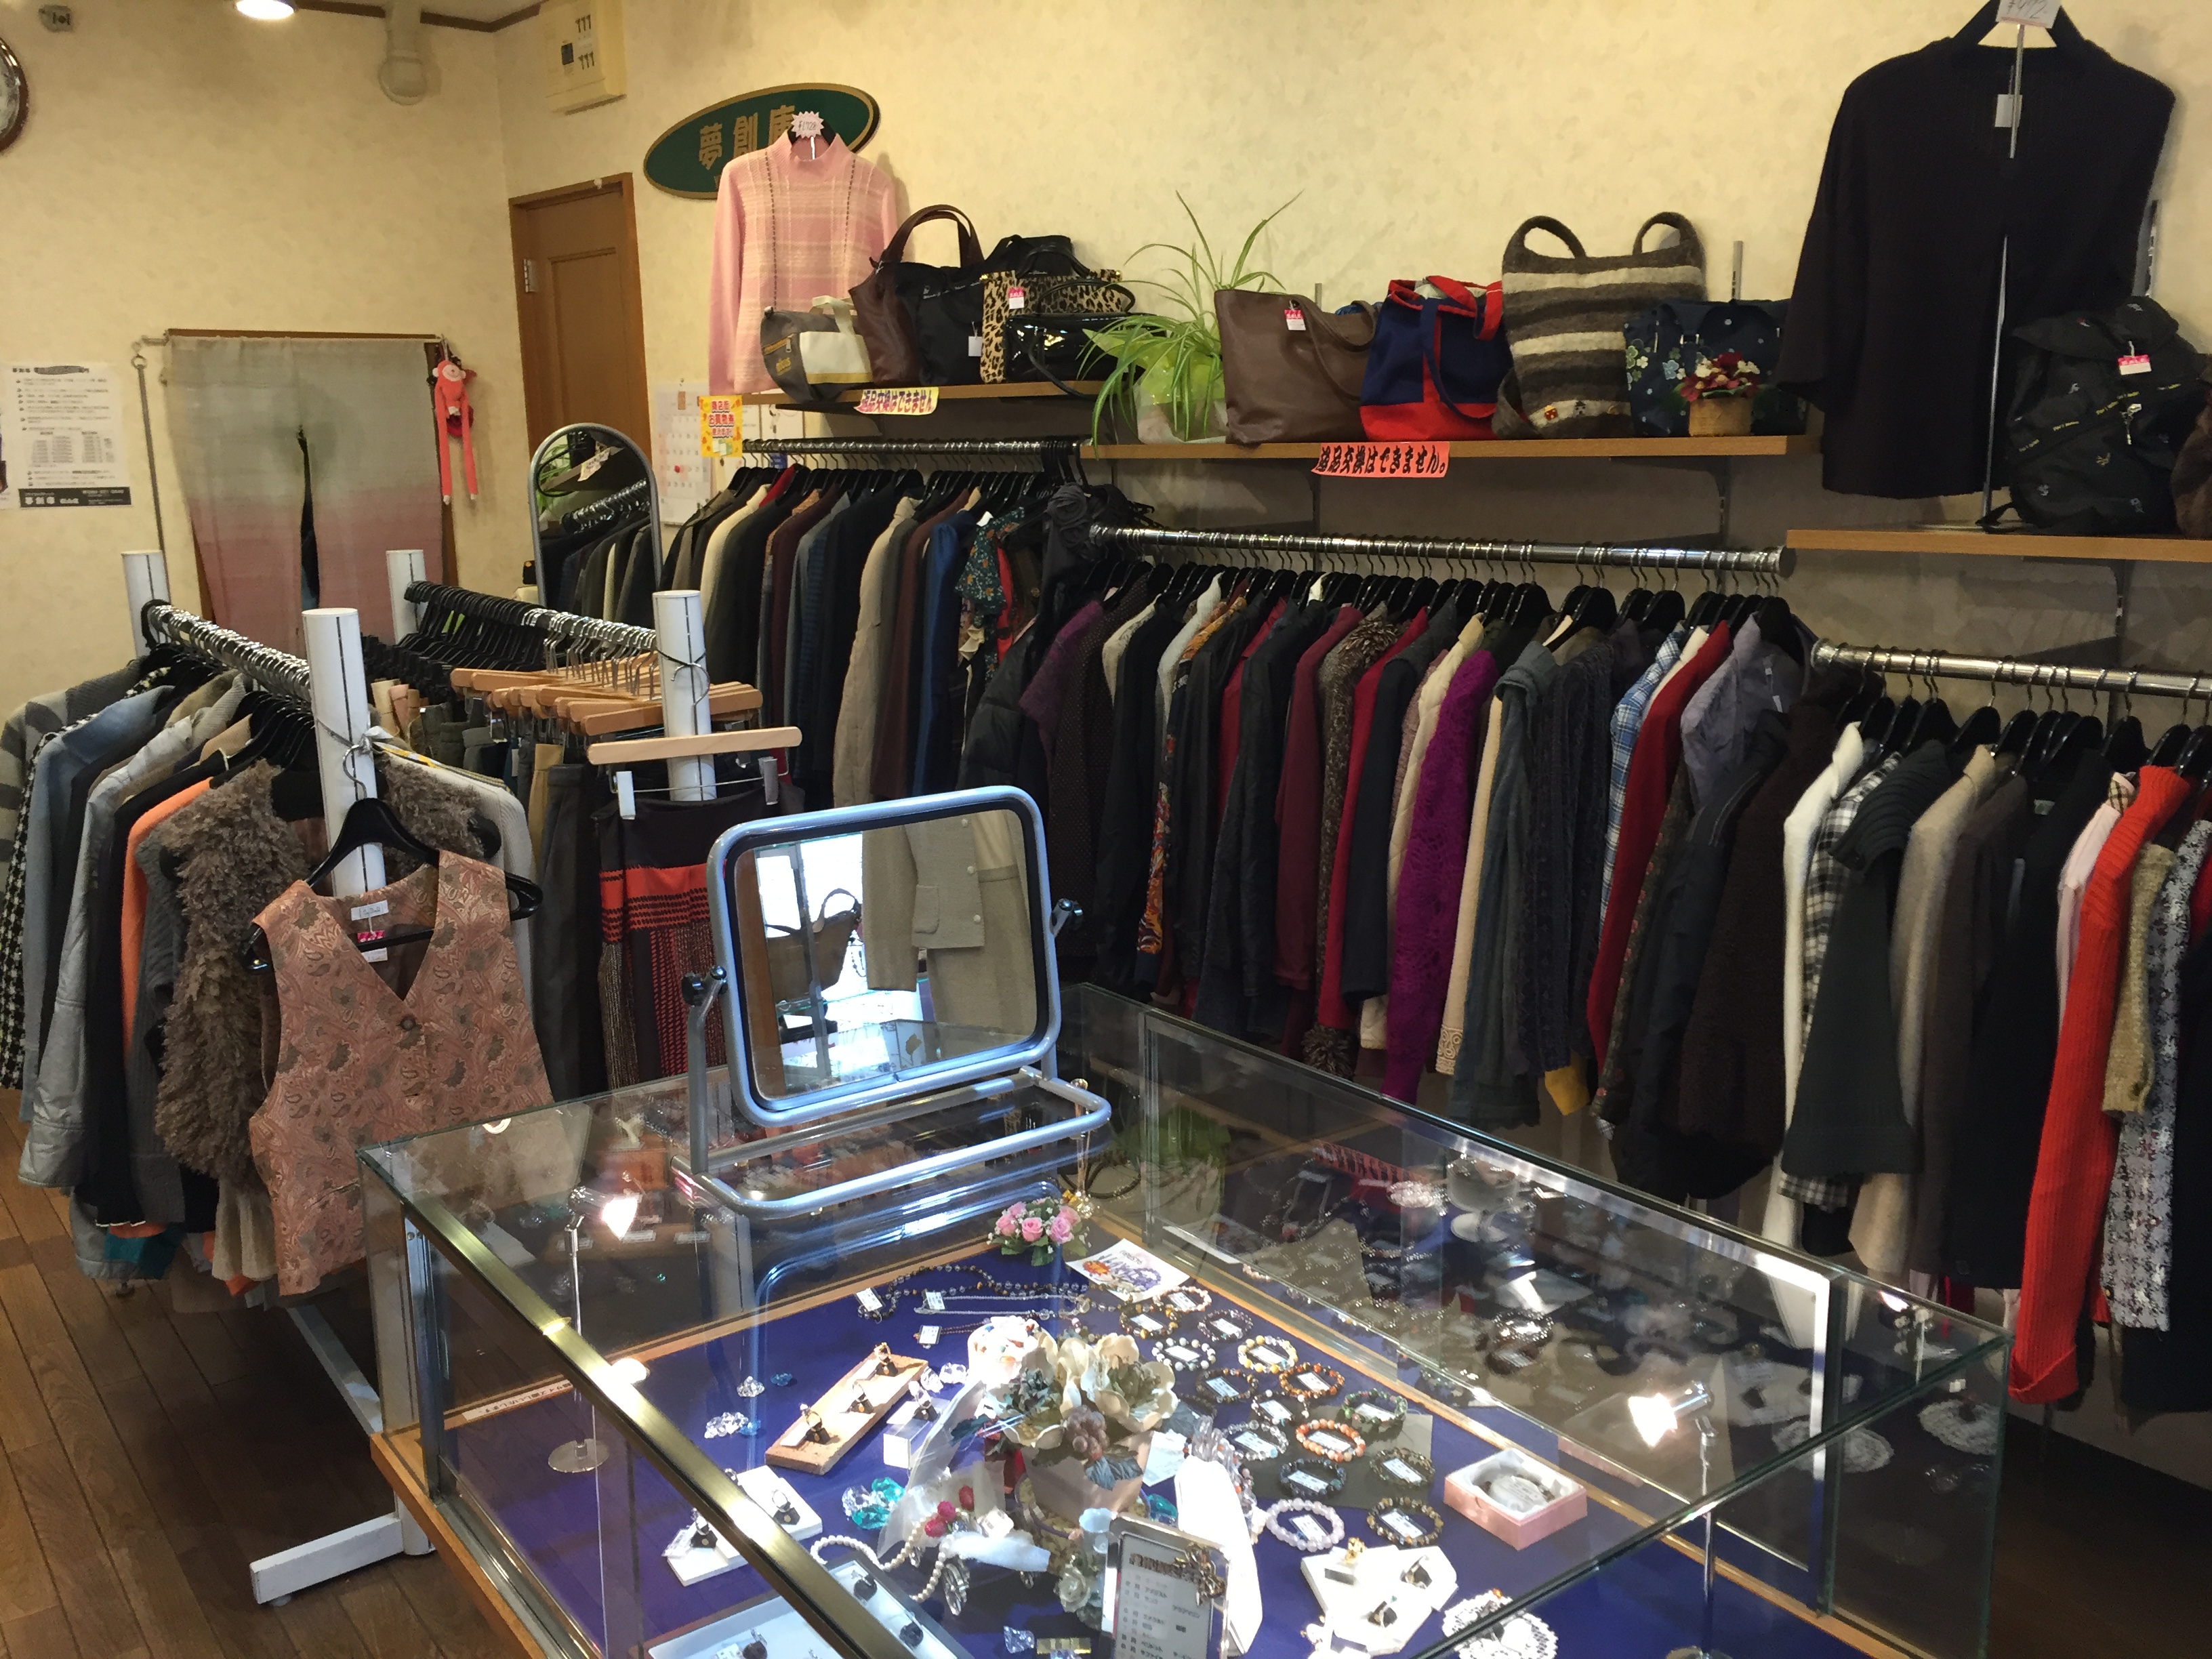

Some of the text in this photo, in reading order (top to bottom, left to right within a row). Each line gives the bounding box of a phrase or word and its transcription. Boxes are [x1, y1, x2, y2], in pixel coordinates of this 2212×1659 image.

[1315, 445, 1446, 474] 返品交換はできません。
